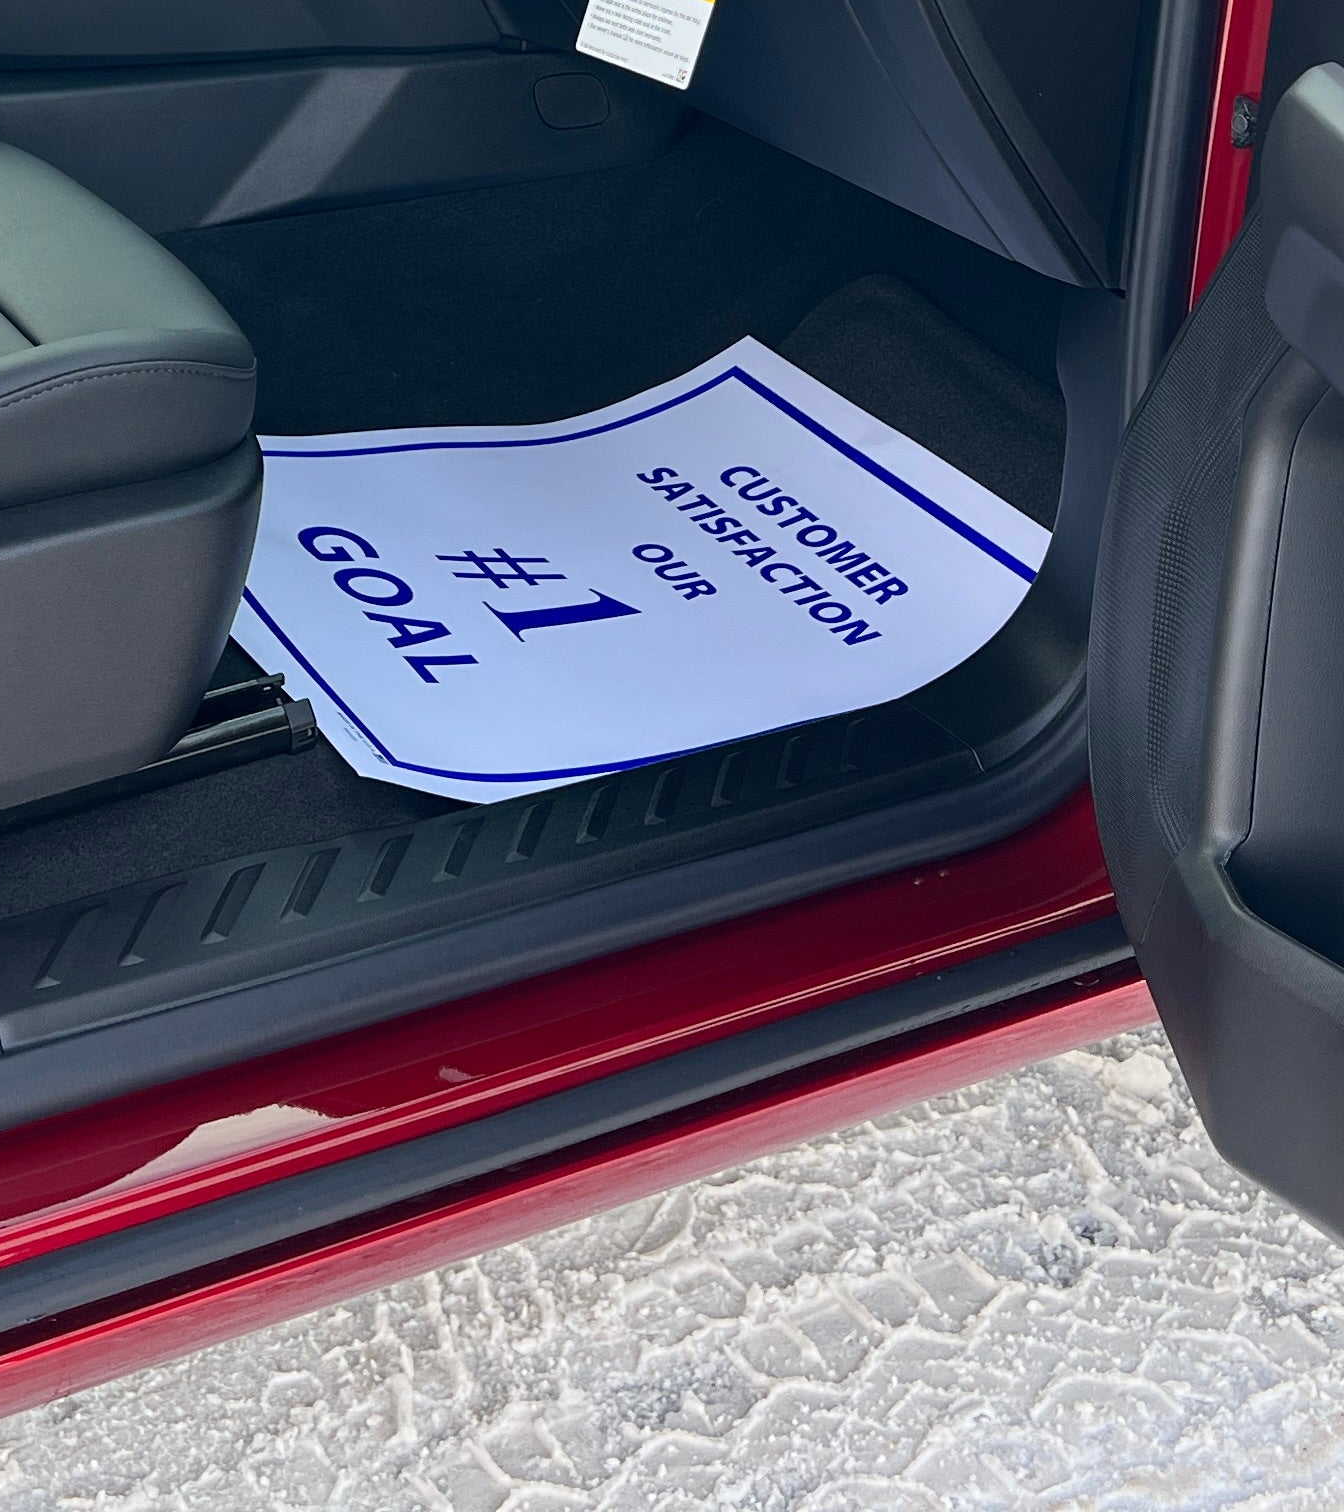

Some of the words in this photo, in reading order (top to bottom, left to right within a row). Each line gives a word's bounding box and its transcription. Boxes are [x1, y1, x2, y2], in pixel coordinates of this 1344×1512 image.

[298, 526, 480, 684] GOAL
[435, 547, 642, 643] #1
[632, 543, 717, 601] OUR
[636, 467, 883, 646] SATISFACTION
[720, 467, 909, 606] CUSTOMER
